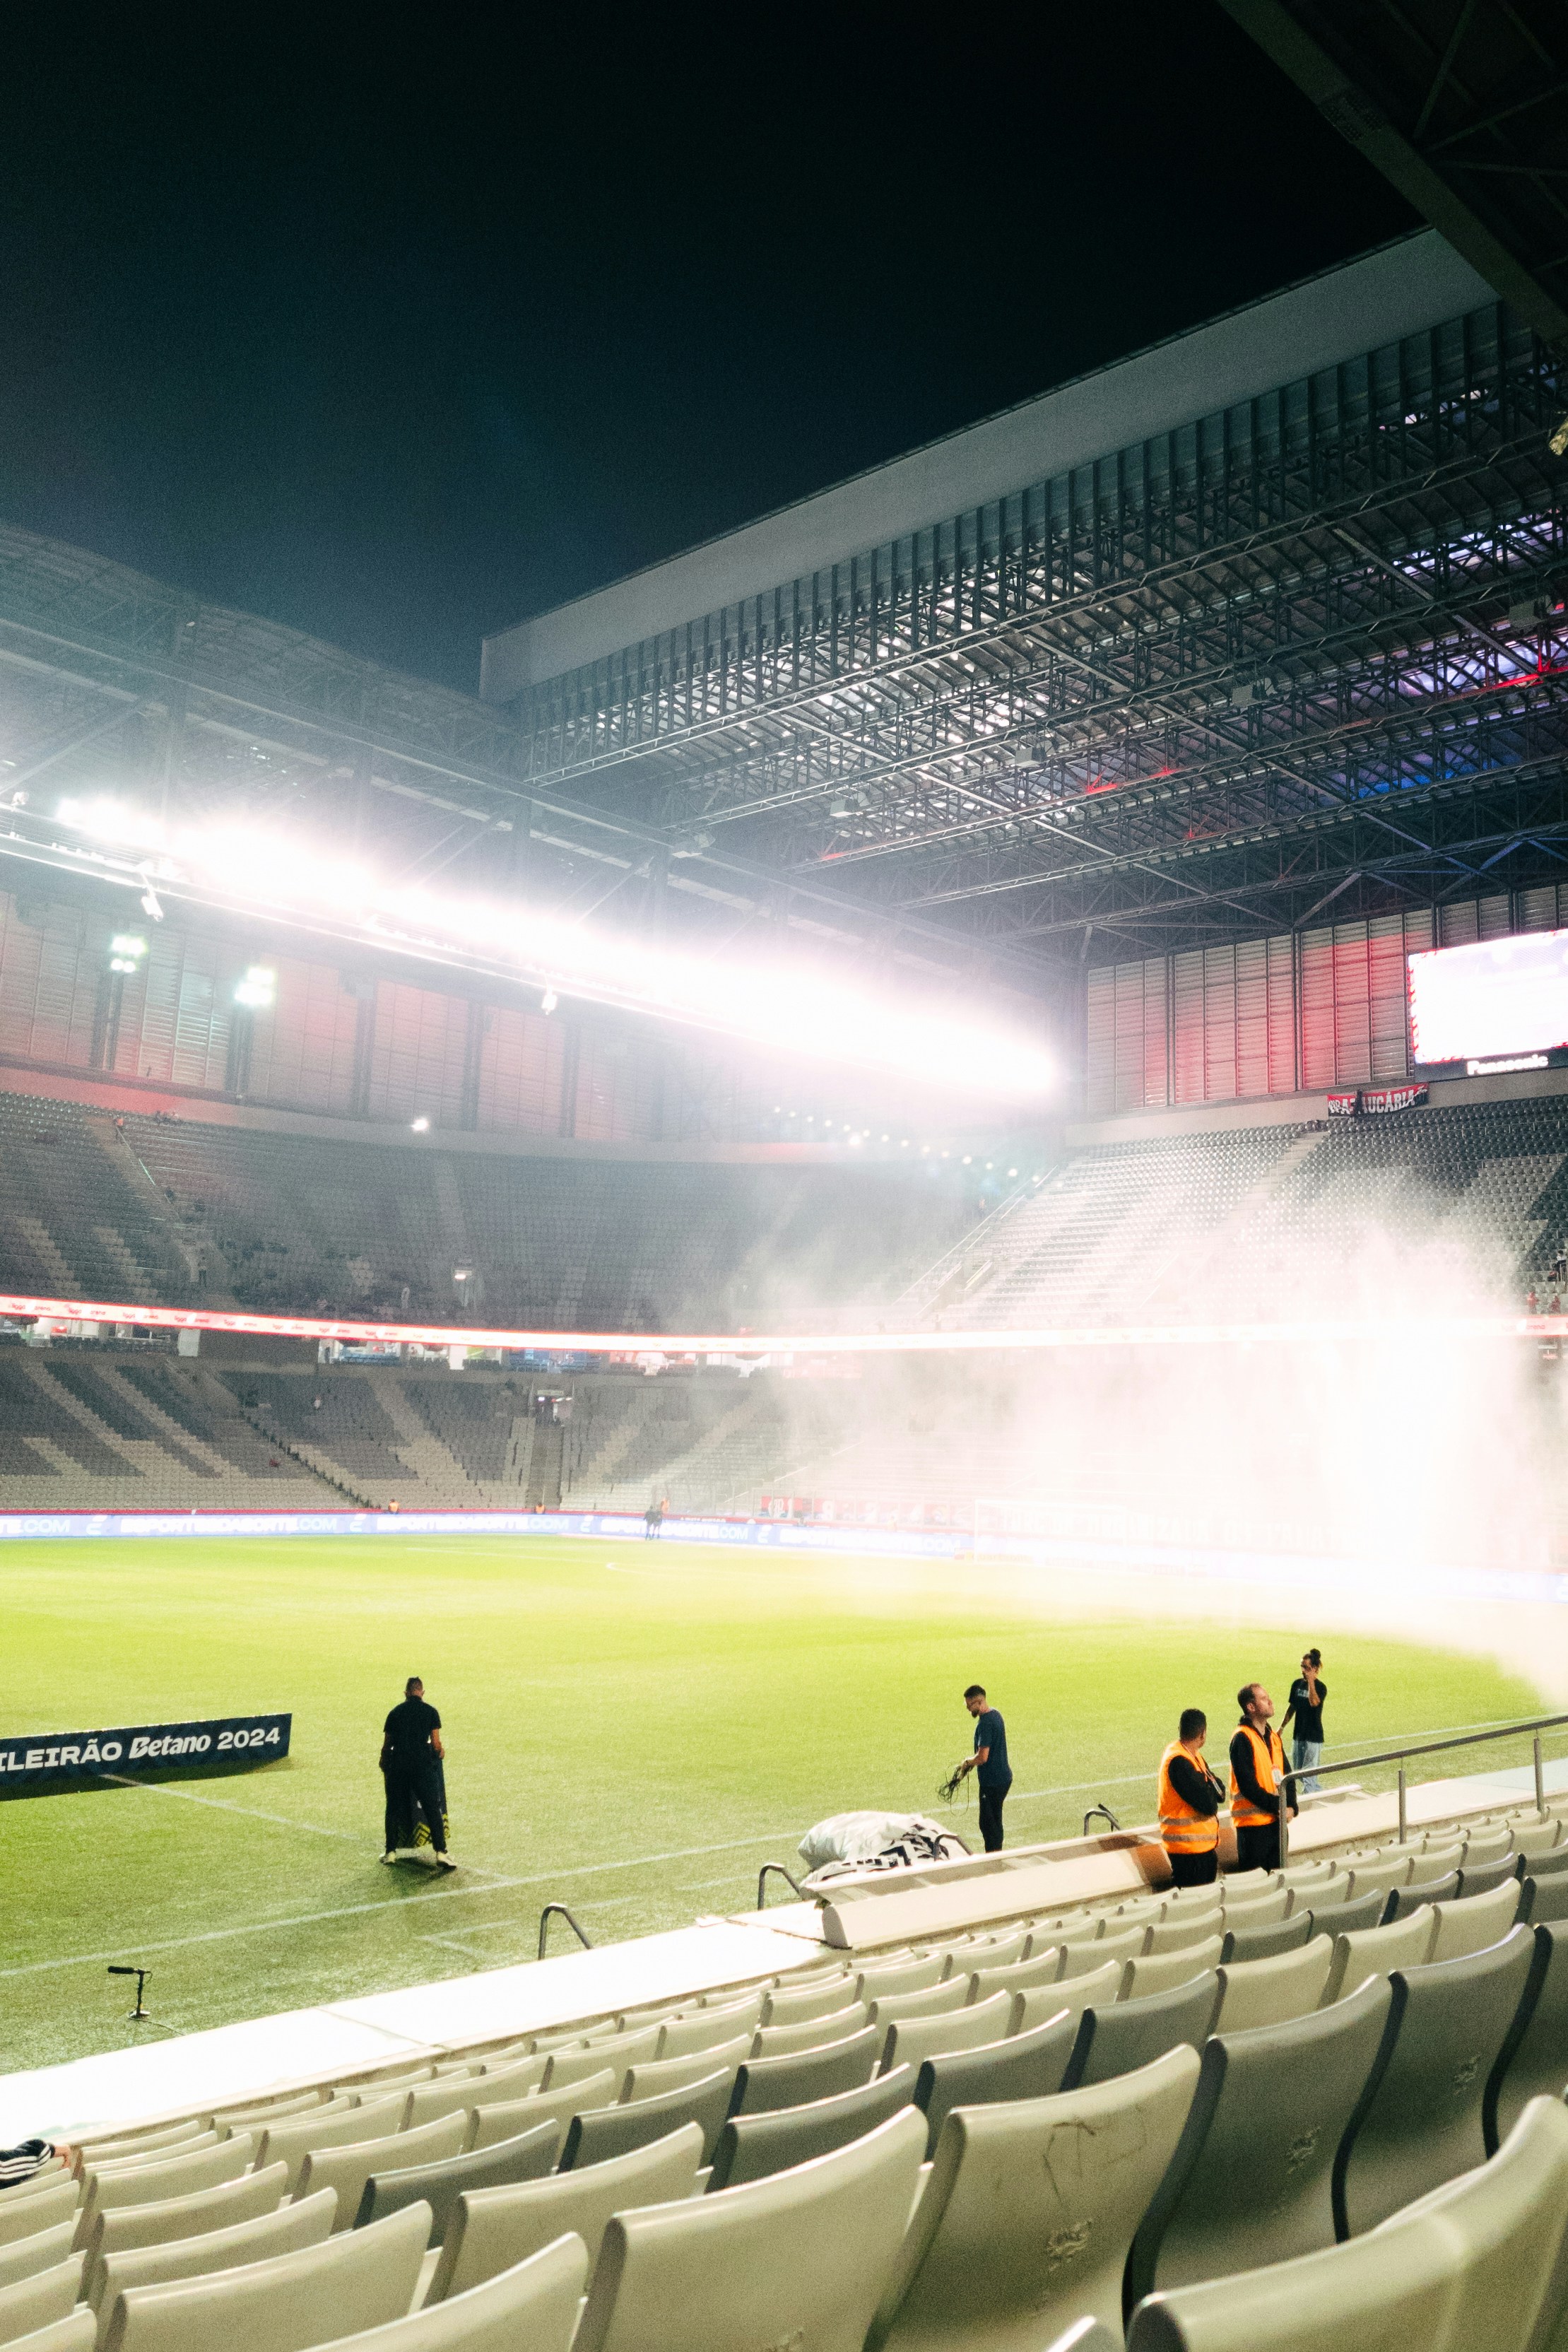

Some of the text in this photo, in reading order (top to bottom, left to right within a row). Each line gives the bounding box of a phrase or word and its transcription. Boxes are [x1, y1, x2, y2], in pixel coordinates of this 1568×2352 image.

[1467, 1054, 1548, 1074] Panasonic
[129, 1735, 211, 1758] Betano
[217, 1727, 280, 1750] 2024
